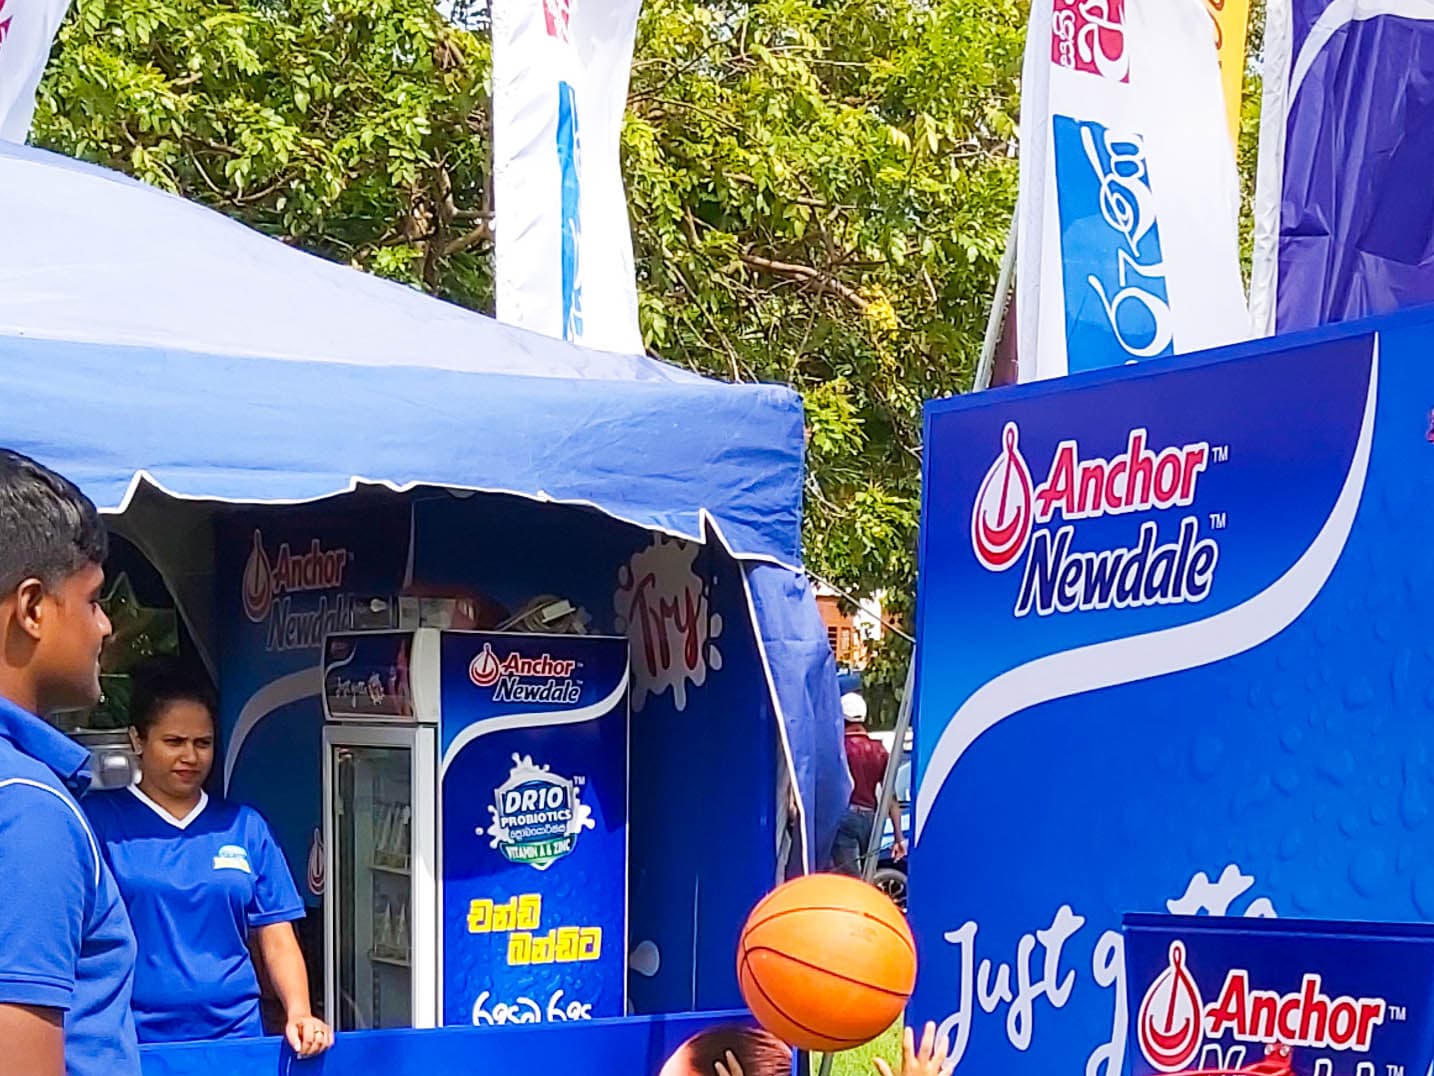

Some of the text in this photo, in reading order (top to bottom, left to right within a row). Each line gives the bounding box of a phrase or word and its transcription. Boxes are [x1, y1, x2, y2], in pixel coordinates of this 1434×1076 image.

[1033, 428, 1209, 523] Anchor
[272, 538, 346, 594] Anchor
[1014, 515, 1219, 617] Newdale
[501, 652, 575, 677] Anchor
[630, 572, 703, 677] Try
[493, 676, 580, 704] Newdale
[501, 809, 572, 828] PROBIOTICS
[936, 904, 1085, 1069] Just
[1204, 969, 1385, 1051] Anchor
